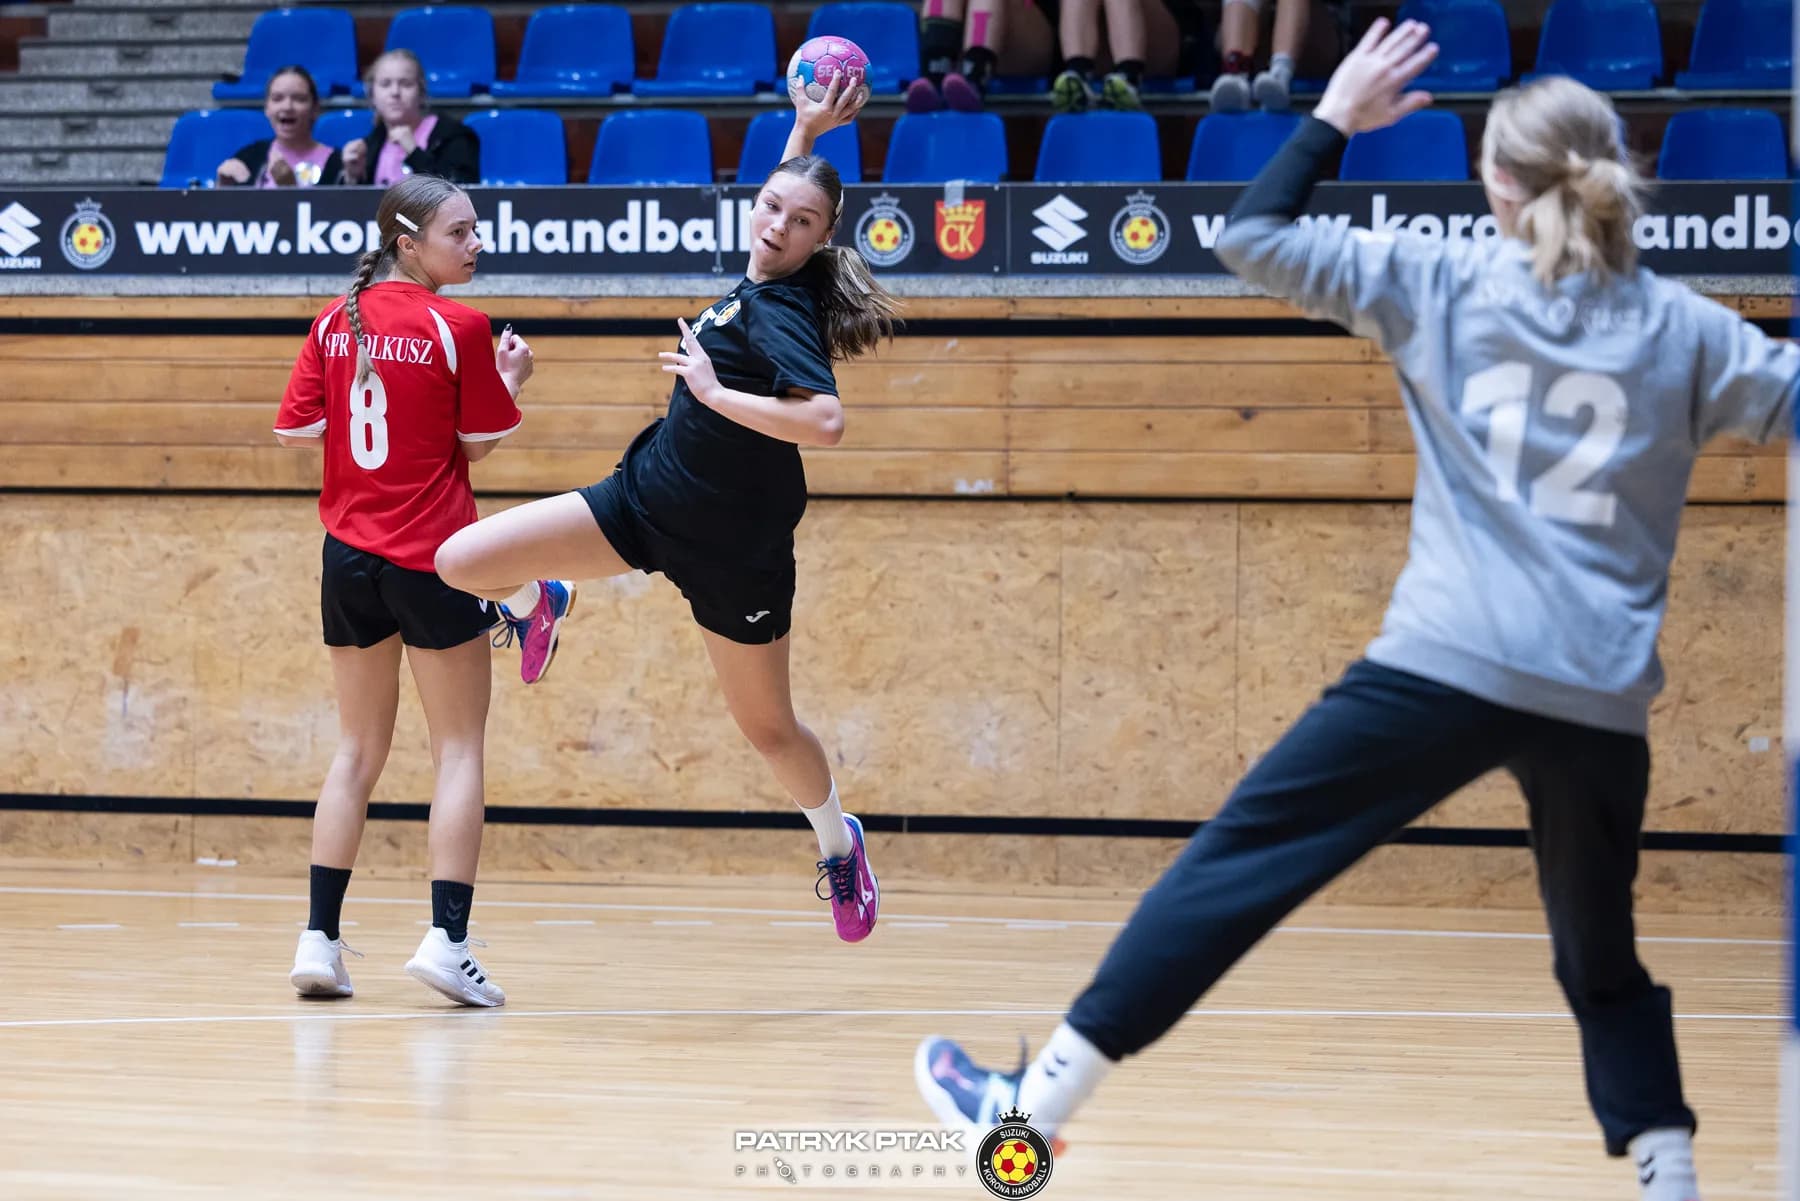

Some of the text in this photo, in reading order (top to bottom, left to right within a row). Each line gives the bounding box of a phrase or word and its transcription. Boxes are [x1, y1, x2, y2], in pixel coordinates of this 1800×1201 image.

[940, 223, 975, 254] CK
[0, 256, 42, 269] UZUKI
[1031, 251, 1089, 264] SUZUKI
[325, 332, 349, 357] SPR
[350, 370, 389, 470] 8
[1461, 361, 1628, 528] 12
